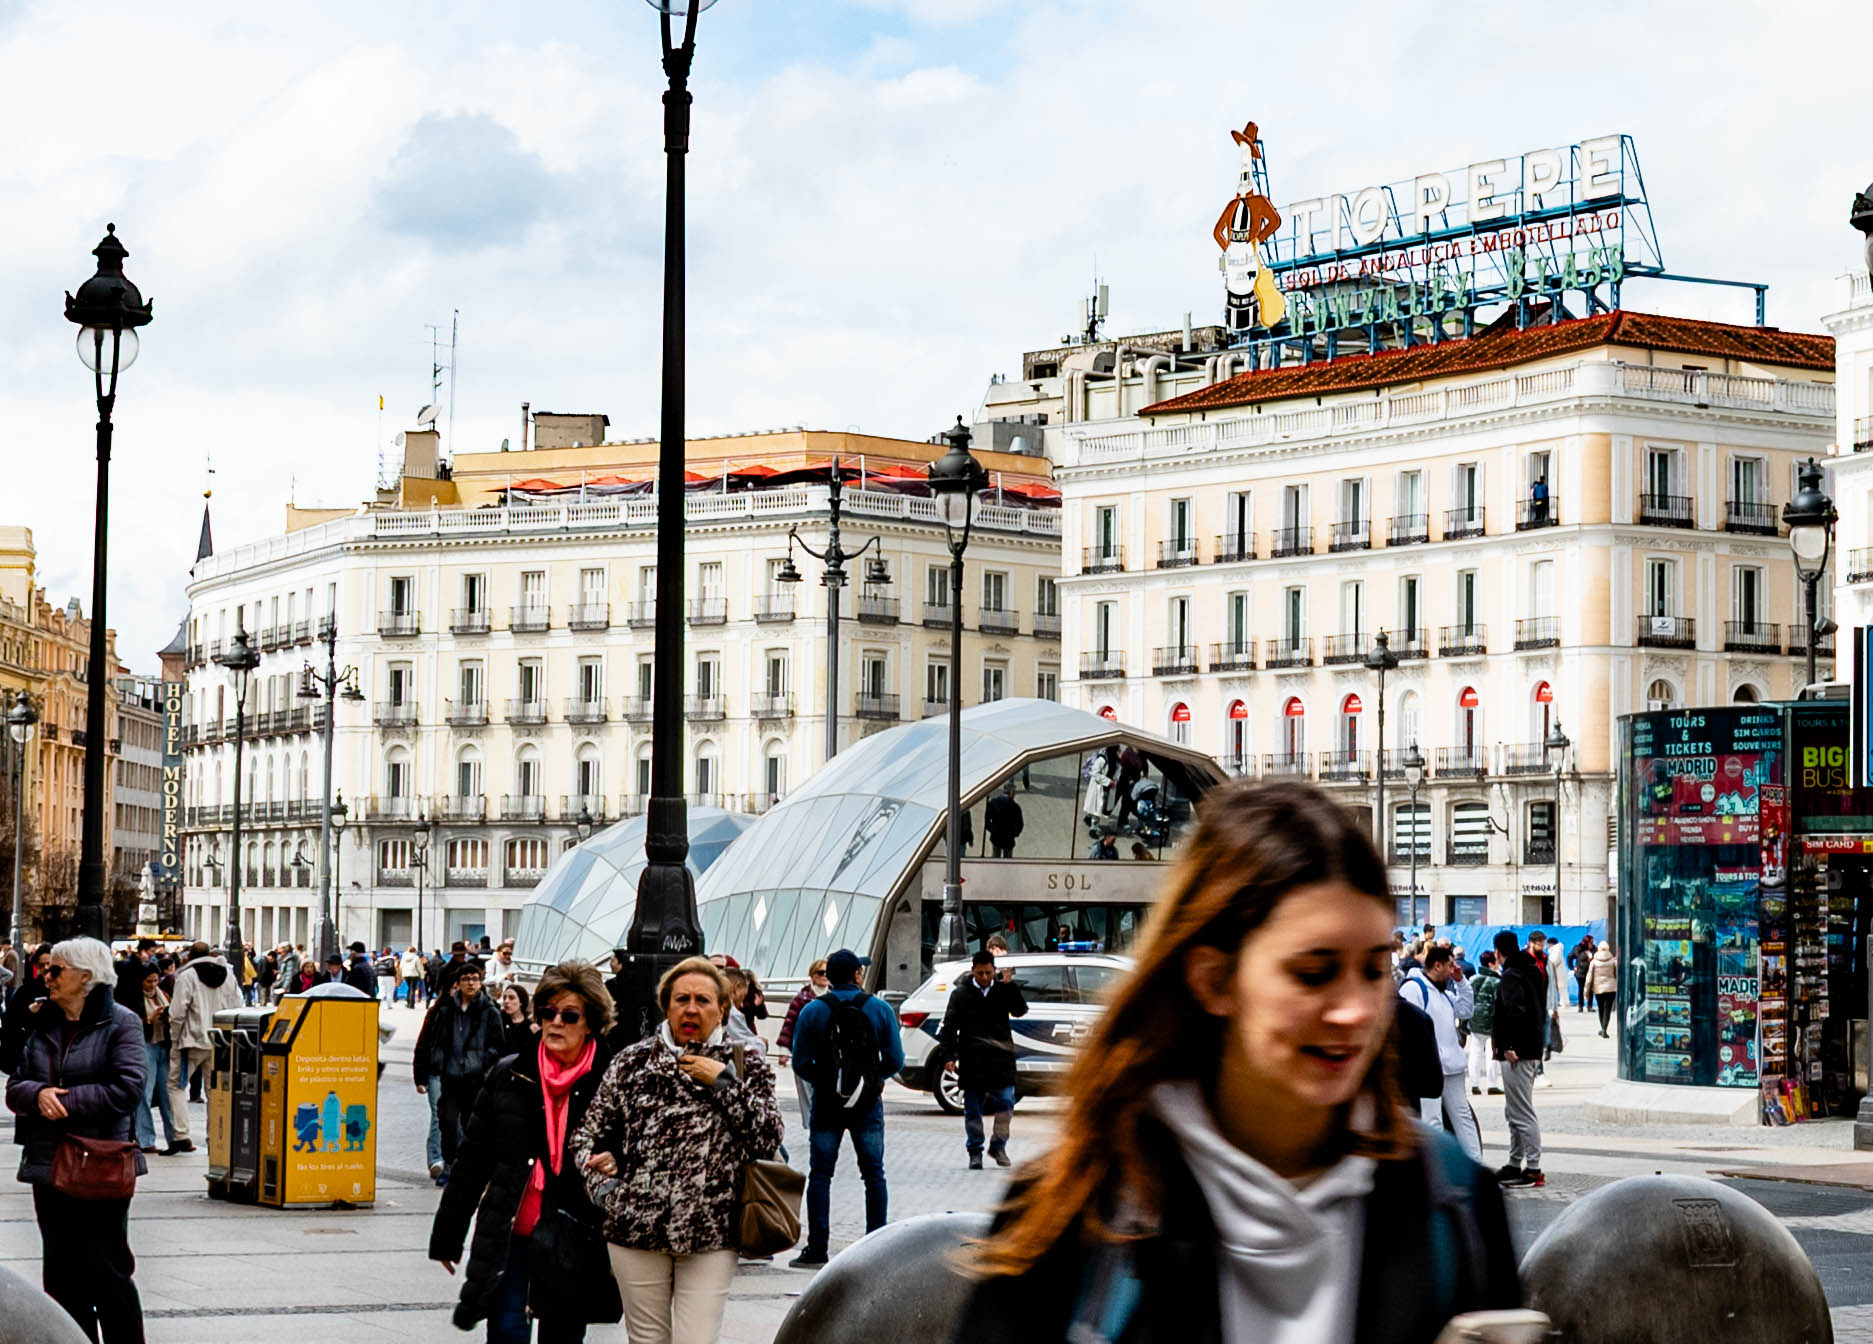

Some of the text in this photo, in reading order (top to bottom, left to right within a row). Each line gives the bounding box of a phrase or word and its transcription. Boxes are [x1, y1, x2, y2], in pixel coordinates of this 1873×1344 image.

[1290, 134, 1622, 256] TIO PEPE
[1286, 268, 1322, 291] SOL
[1328, 263, 1349, 283] DE
[1470, 212, 1620, 256] EMBOTELLADO
[1289, 243, 1624, 336] GONZALEZ BYASS
[166, 683, 181, 756] HOTEL
[1670, 716, 1706, 728] TOURS
[1681, 730, 1689, 741] &
[1734, 729, 1750, 737] SIM
[1664, 742, 1712, 755] TICKETS
[1803, 746, 1844, 767] BIG
[1668, 758, 1716, 776] MADRID
[1803, 768, 1844, 788] BUS
[162, 766, 181, 867] MODERNO
[1826, 841, 1854, 849] CARD
[1047, 873, 1091, 890] SOL
